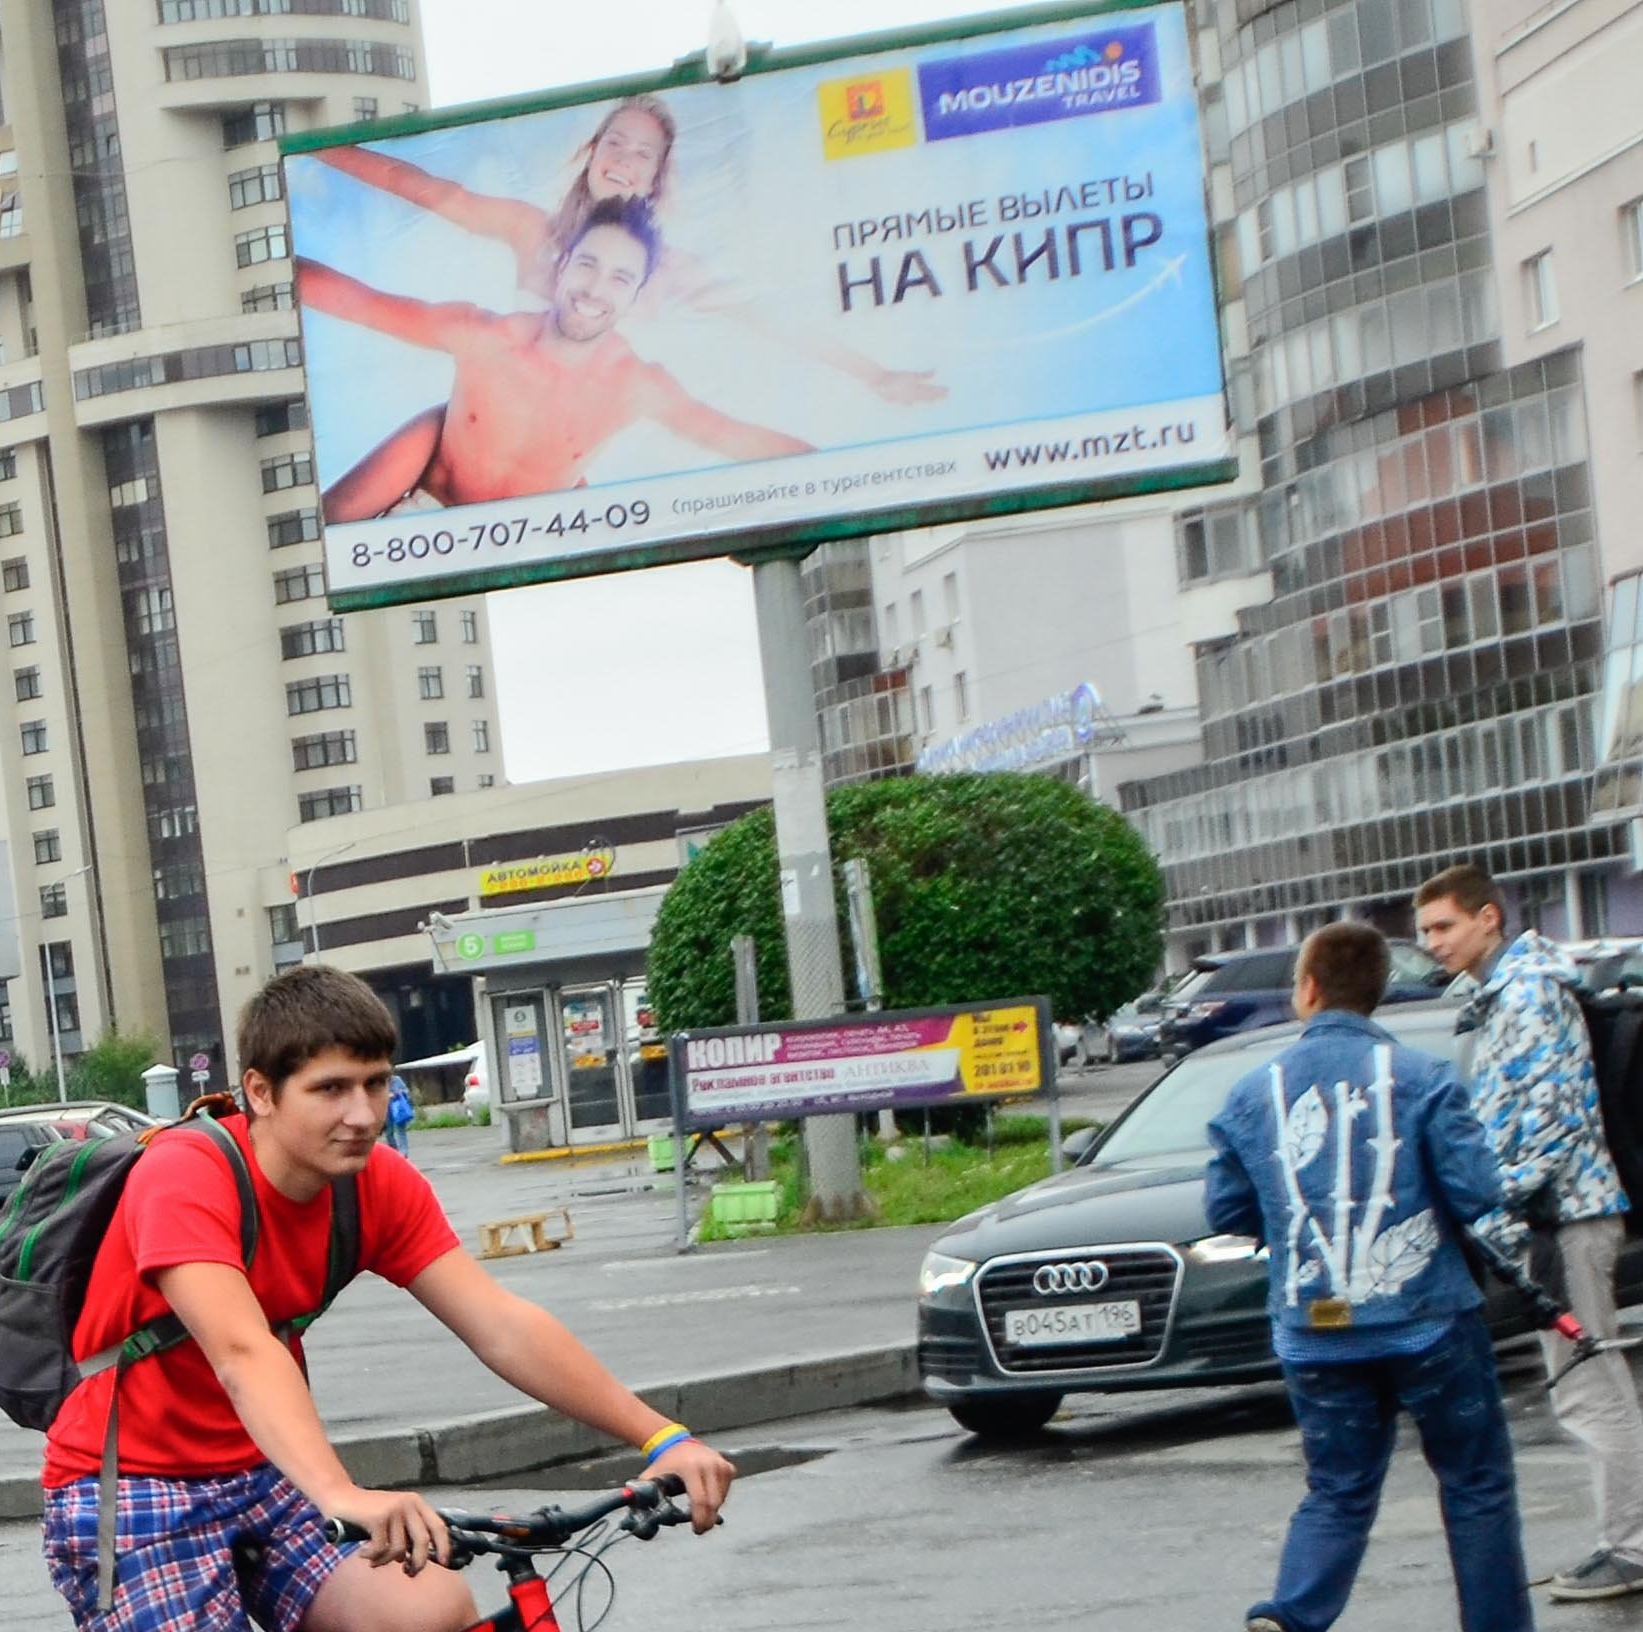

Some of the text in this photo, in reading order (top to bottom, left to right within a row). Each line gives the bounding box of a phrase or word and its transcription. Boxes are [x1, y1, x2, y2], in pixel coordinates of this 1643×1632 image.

[938, 59, 1142, 115] MOUZENIDIS
[1062, 86, 1141, 108] TRAVEL
[832, 171, 1154, 251] ПРЯМЫЕ ВЫЛЕТЫ
[837, 211, 1164, 312] НА КИПР
[983, 420, 1196, 473] www.mzt.ru
[804, 479, 816, 496] в
[351, 500, 651, 568] 8-800-707-44-09
[487, 861, 582, 884] АВТОМОЙКА
[464, 935, 478, 951] 5
[686, 1032, 783, 1069] КОПИР
